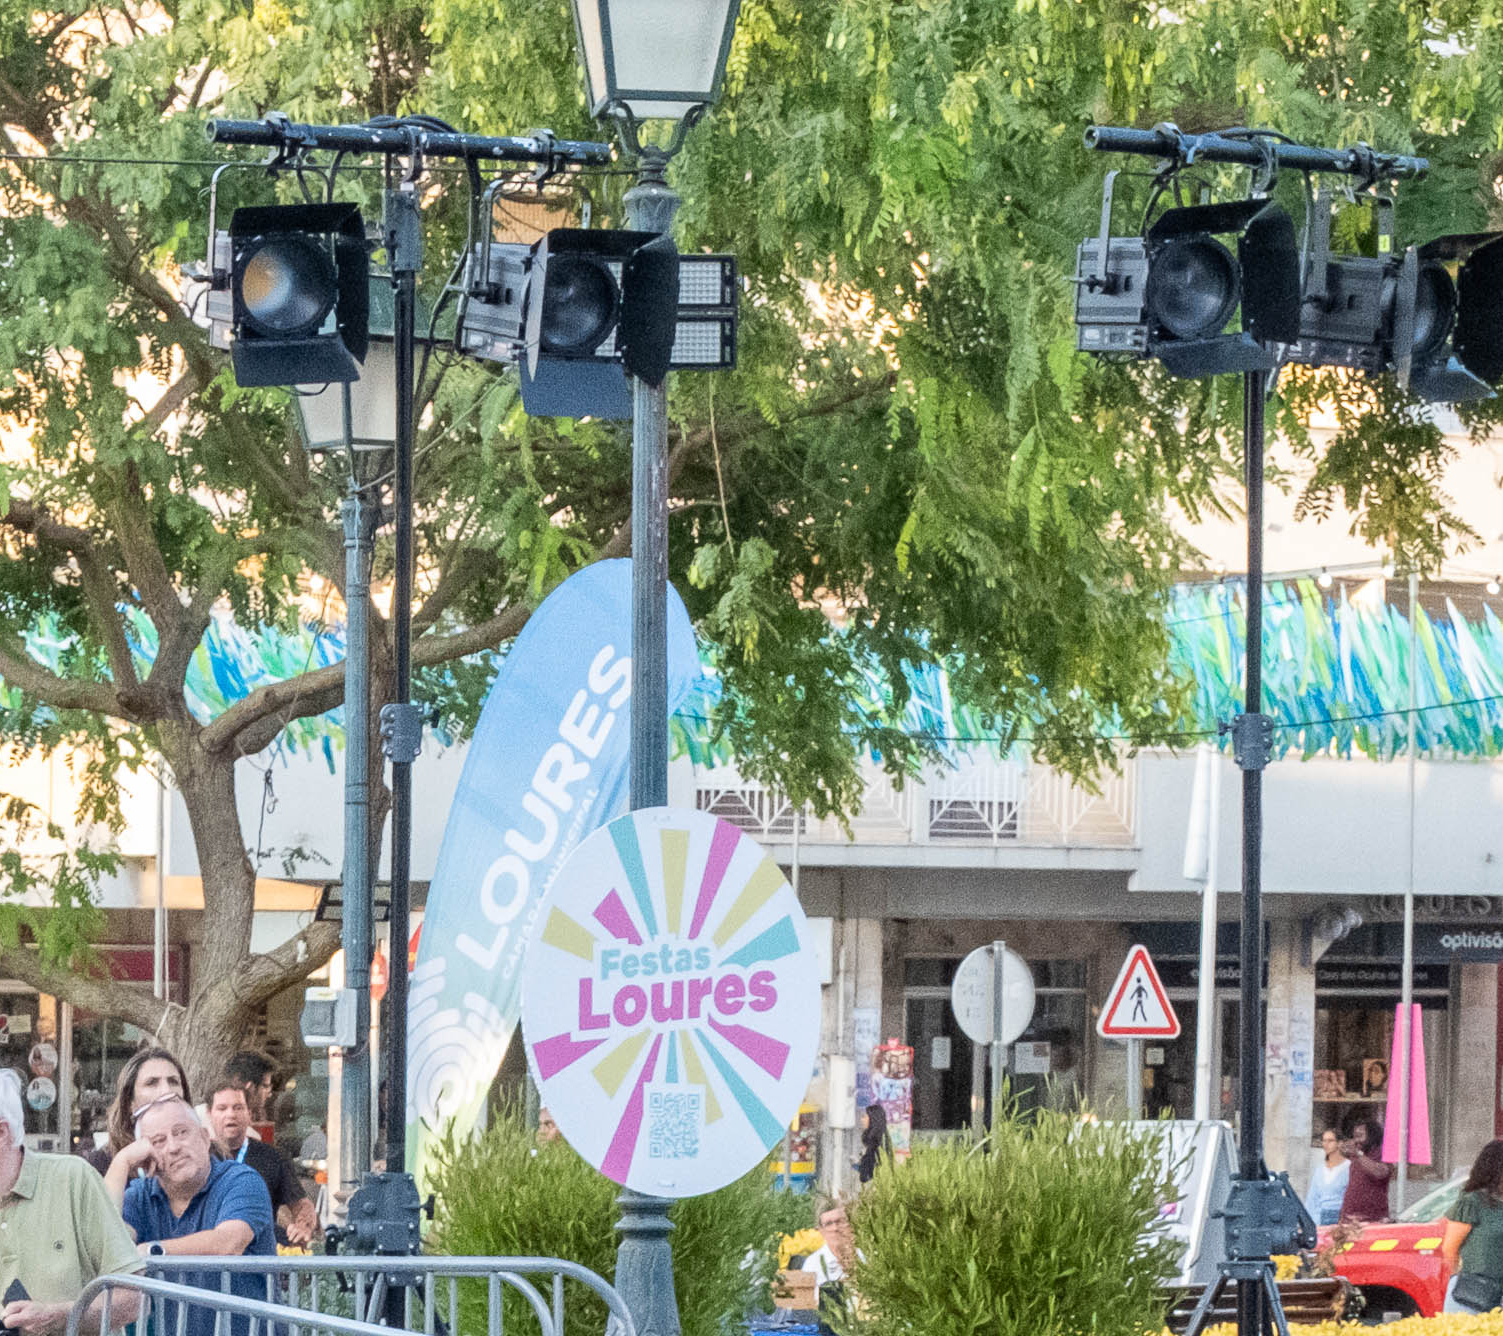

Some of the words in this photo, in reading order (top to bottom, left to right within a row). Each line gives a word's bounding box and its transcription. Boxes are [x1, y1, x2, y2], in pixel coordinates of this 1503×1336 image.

[455, 643, 633, 971] LOURES
[600, 943, 712, 981] Festas
[579, 970, 778, 1031] Loures
